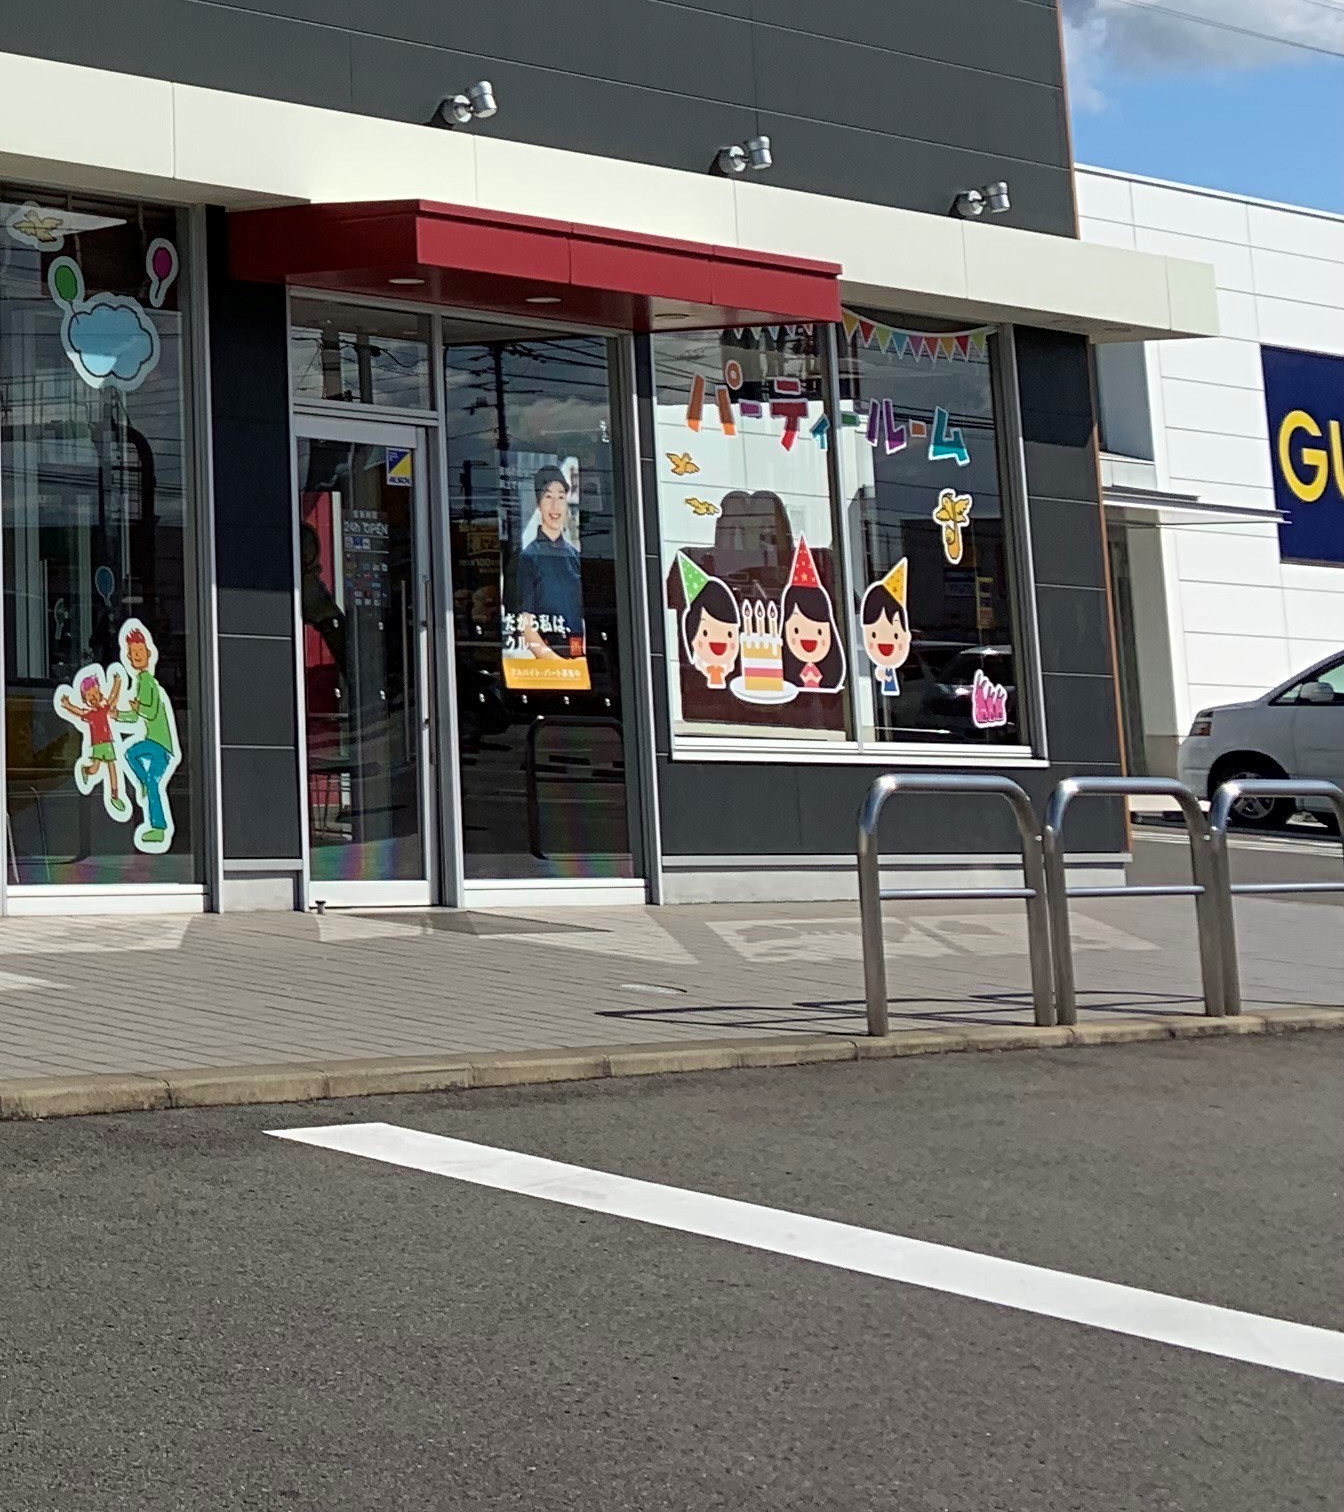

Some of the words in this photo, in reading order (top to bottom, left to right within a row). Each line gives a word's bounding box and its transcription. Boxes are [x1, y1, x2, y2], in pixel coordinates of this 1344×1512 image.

[687, 360, 970, 467] パーティールーム
